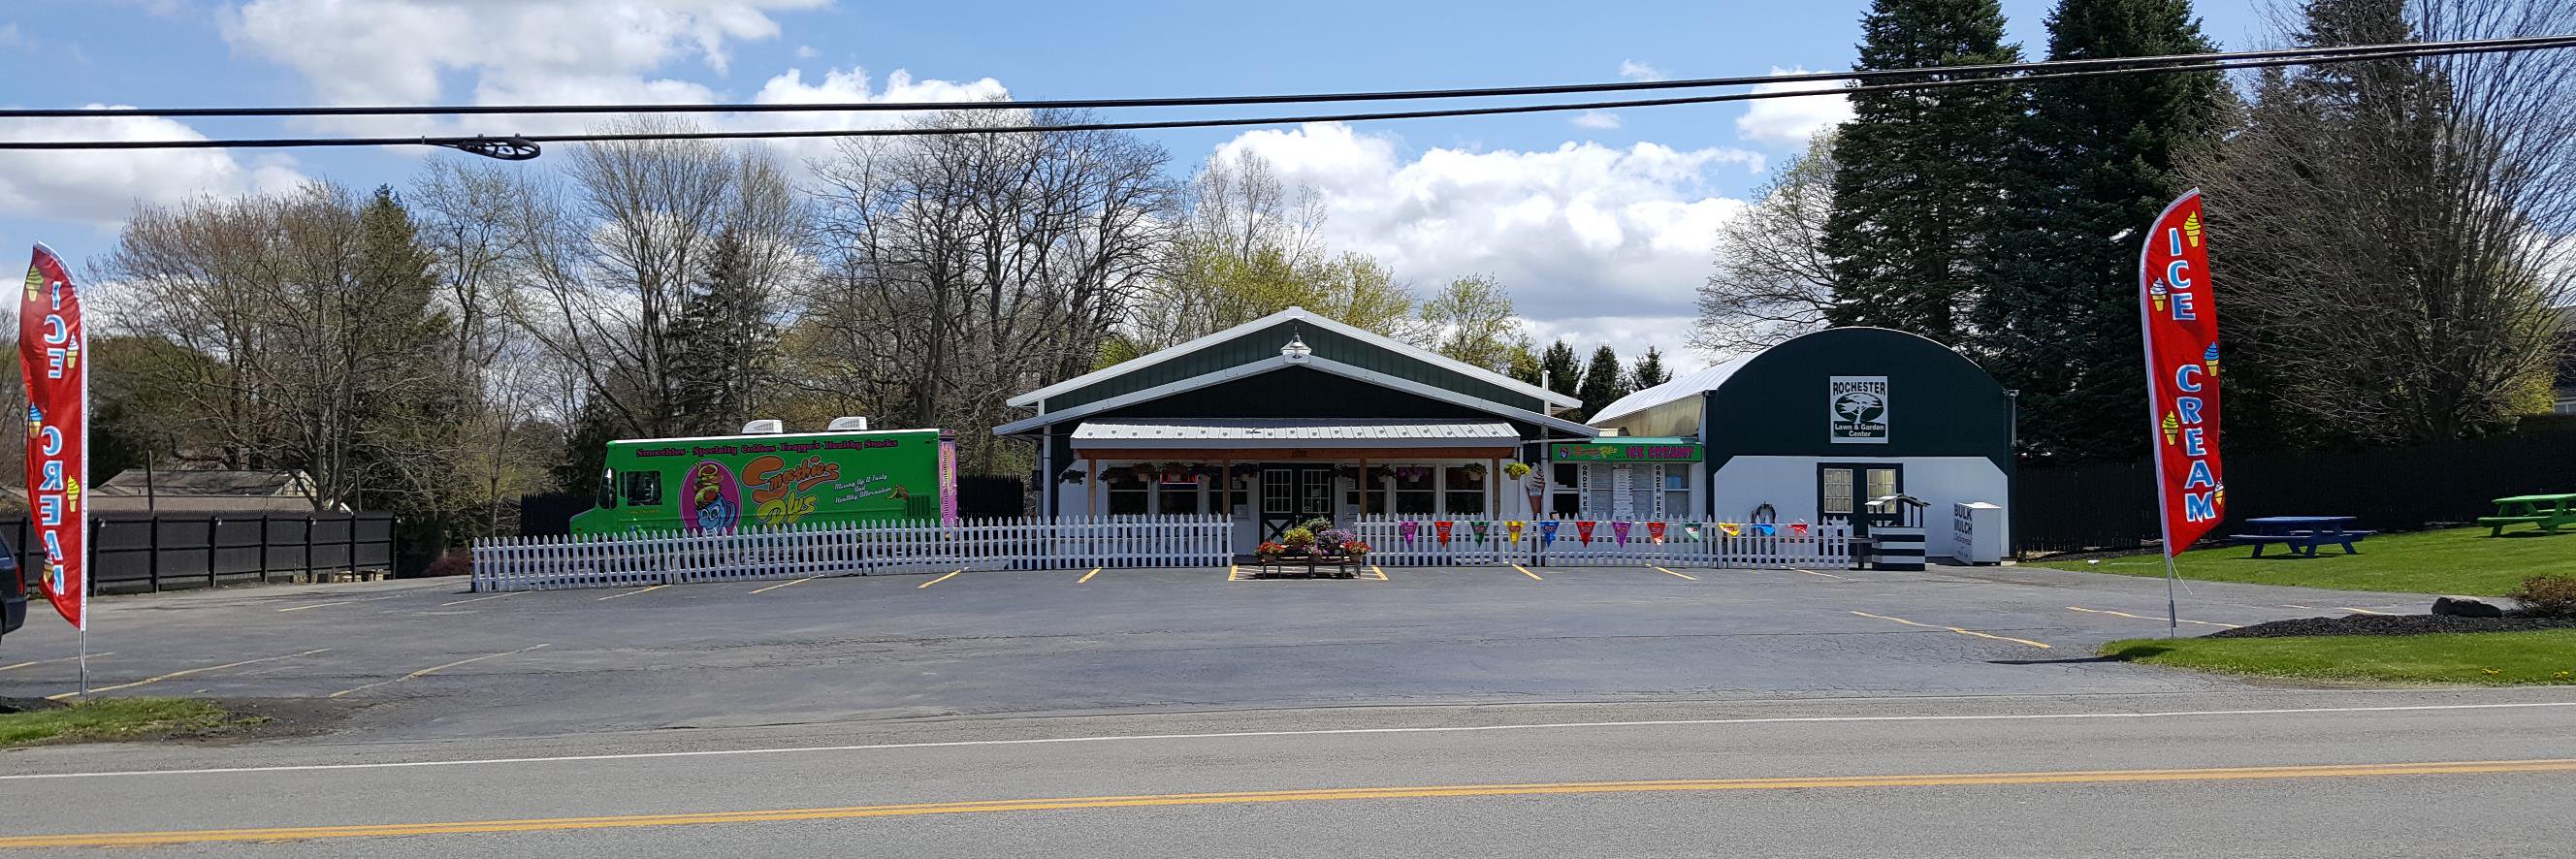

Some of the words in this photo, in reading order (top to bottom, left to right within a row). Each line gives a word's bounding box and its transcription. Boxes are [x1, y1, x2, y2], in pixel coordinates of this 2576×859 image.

[2167, 227, 2196, 321] ICE
[1832, 381, 1886, 397] ROCHESTER
[636, 447, 686, 457] Smoothies
[692, 445, 737, 456] Specialty
[823, 440, 862, 451] Healthy
[864, 438, 898, 448] Snacks
[1625, 446, 1645, 459] ICE
[2175, 364, 2216, 523] CREAM
[756, 492, 818, 527] Plus
[1954, 503, 1973, 522] BULK
[1954, 518, 1973, 535] MULCH
